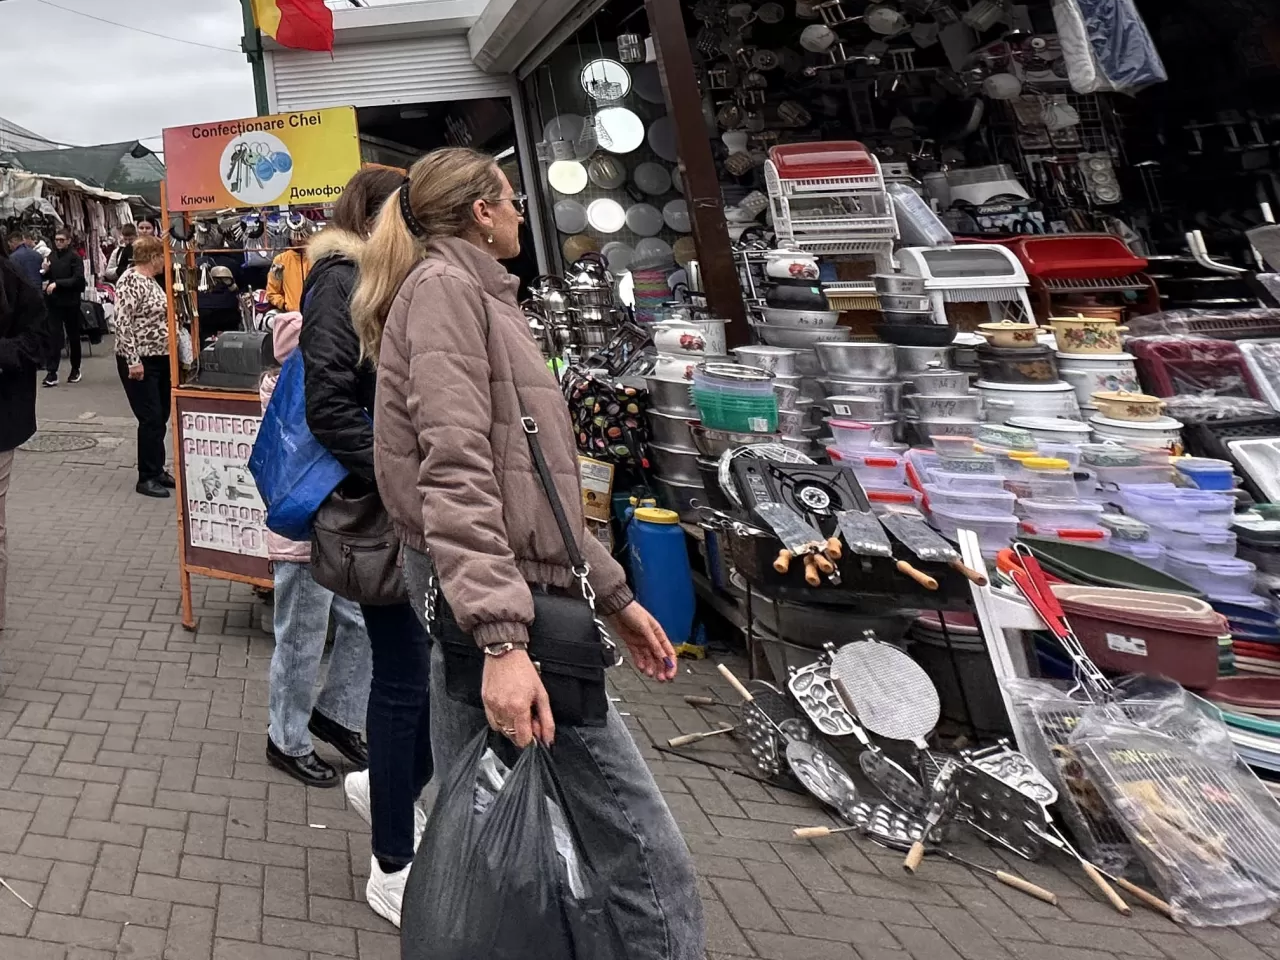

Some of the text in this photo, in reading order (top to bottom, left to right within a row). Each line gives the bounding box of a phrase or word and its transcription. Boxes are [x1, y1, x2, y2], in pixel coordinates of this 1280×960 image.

[191, 112, 322, 139] Confecționare Chei
[180, 195, 215, 206] Ключи
[290, 185, 346, 199] Домофо
[183, 437, 255, 460] CHEILO
